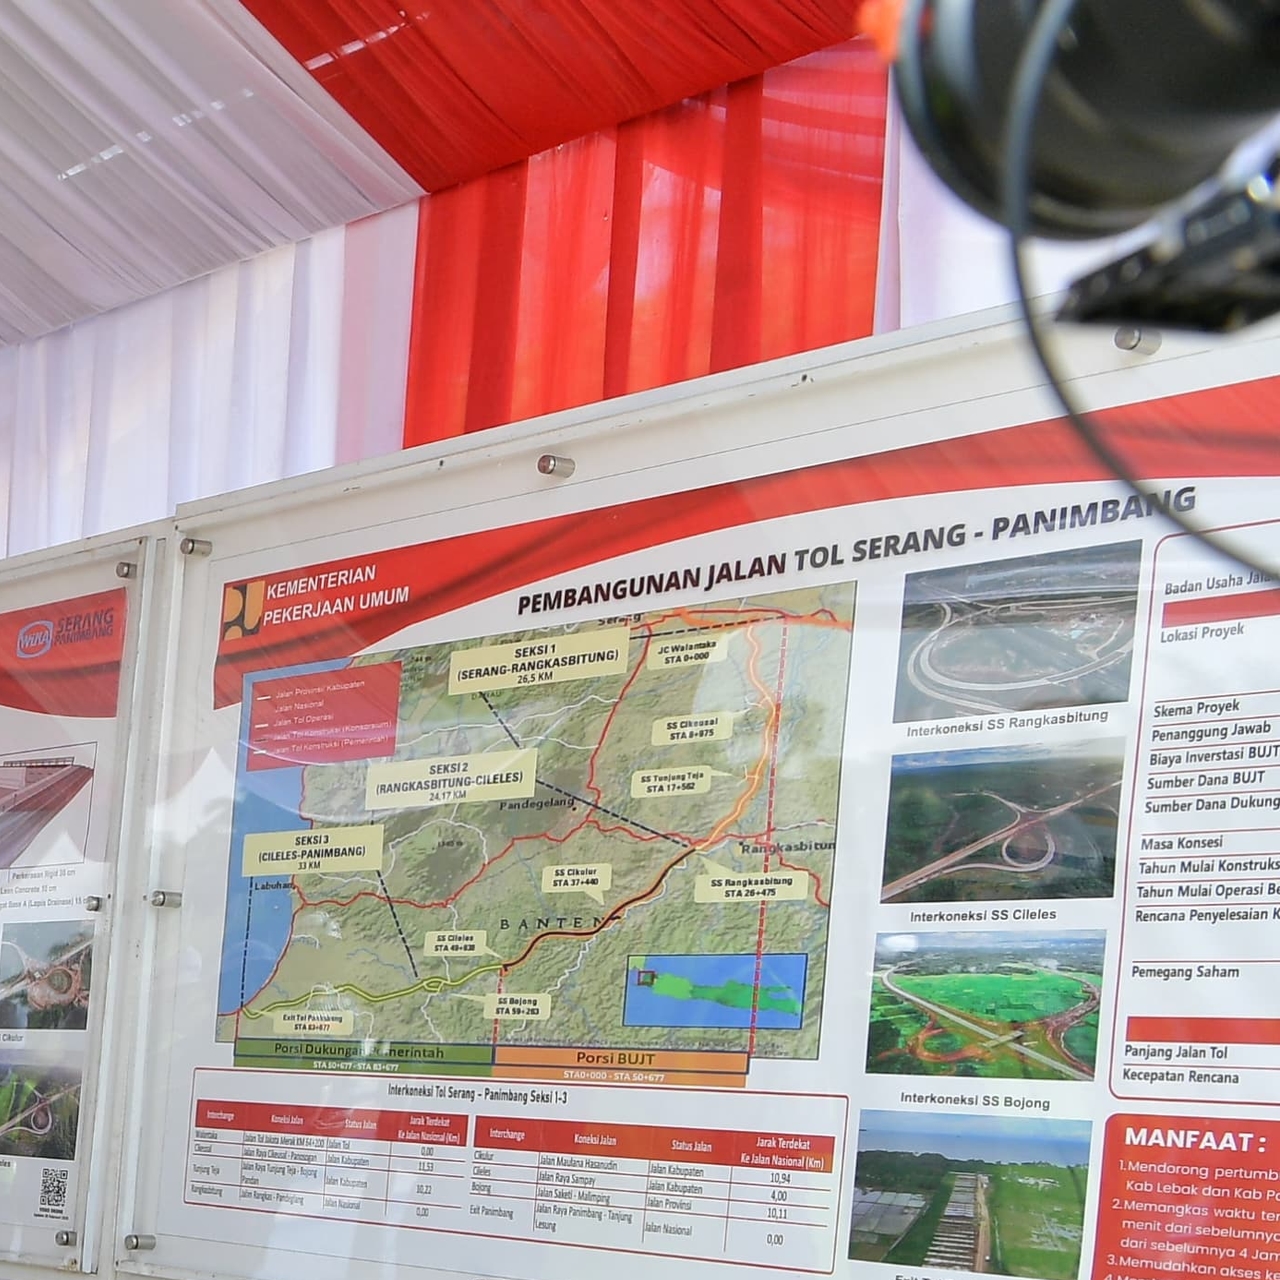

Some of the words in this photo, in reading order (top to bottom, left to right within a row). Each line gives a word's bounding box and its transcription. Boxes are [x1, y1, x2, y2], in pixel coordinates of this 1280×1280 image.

[517, 567, 701, 615] PEMBANGUNAN
[704, 553, 787, 591] JALAN
[795, 544, 845, 570] TOL
[851, 523, 966, 563] SERANG
[991, 486, 1196, 540] PANIMBANG
[267, 565, 376, 600] KEMENTERIAN
[1164, 580, 1202, 596] Badan
[1206, 575, 1243, 591] Usaha
[263, 596, 354, 626] PEKERJAAN
[359, 586, 409, 609] UMUM
[1161, 627, 1198, 643] Lokasi
[1201, 623, 1244, 641] Proyek
[515, 645, 549, 658] SEKSI
[550, 645, 556, 654] 1
[658, 644, 670, 654] JC
[671, 641, 716, 653] Walantaka
[458, 650, 620, 682] (SERANG-RANGKASBITUNG)
[664, 654, 682, 664] STA
[517, 673, 536, 684] 26,5
[538, 672, 553, 681] KM
[1153, 705, 1193, 717] Skema
[1197, 699, 1240, 716] Proyek
[907, 719, 984, 738] Interkoneksi
[987, 718, 1006, 731] SS
[1009, 709, 1109, 730] Rangkasbitung
[1152, 725, 1228, 742] Penanggung
[1231, 720, 1271, 736] Jawab
[1150, 753, 1182, 768] Biaya
[1185, 747, 1244, 763] Inverstasi
[1248, 745, 1280, 759] BUJT
[429, 764, 461, 775] SEKSI
[461, 762, 469, 772] 2
[376, 772, 523, 795] (RANGKASBITUNG-CILELES)
[1147, 776, 1195, 790] Sumber
[1197, 774, 1229, 786] Dana
[1233, 770, 1266, 784] BUJT
[500, 798, 575, 811] Pandegelang
[1145, 800, 1192, 813] Sumber
[1195, 798, 1227, 810] Dana
[295, 836, 322, 846] SEKSI
[322, 835, 329, 844] 3
[1141, 838, 1173, 851] Masa
[1177, 835, 1223, 849] Konsesi
[259, 846, 366, 863] (CILELES-PANIMBANG)
[297, 862, 306, 870] 33
[308, 861, 321, 870] KM
[1140, 862, 1176, 874] Tahun
[1180, 859, 1215, 873] Mulai
[711, 879, 722, 887] SS
[725, 876, 793, 887] Rangkasbitung
[725, 889, 742, 897] STA
[744, 888, 777, 897] 26+475
[1137, 886, 1173, 898] Tahun
[1178, 884, 1212, 897] Mulai
[1215, 882, 1264, 899] Operasi
[910, 910, 987, 923] Interkoneksi
[991, 910, 1009, 920] SS
[1013, 909, 1057, 920] Cileles
[1136, 910, 1185, 923] Rencana
[1189, 908, 1268, 925] Penyelesaian
[1132, 965, 1192, 981] Pemegang
[1196, 966, 1240, 978] Saham
[274, 1043, 302, 1053] Porsi
[1125, 1045, 1173, 1060] Panjang
[1176, 1045, 1206, 1058] Jalan
[1210, 1046, 1228, 1059] Tol
[577, 1051, 614, 1065] Porsi
[618, 1053, 656, 1065] BUJT
[613, 1072, 631, 1081] STA
[632, 1072, 665, 1082] 50+677
[1123, 1068, 1185, 1083] Kecepatan
[1188, 1070, 1239, 1084] Rencana
[388, 1082, 434, 1098] Interkoneksi
[435, 1084, 446, 1098] Tol
[448, 1087, 475, 1102] Serang
[484, 1088, 527, 1105] Panimbang
[530, 1091, 553, 1104] Seksi
[555, 1091, 568, 1104] 1-3
[901, 1092, 979, 1106] Interkoneksi
[982, 1095, 1000, 1106] SS
[1004, 1096, 1050, 1110] Bojong
[574, 1133, 598, 1145] Koneksi
[599, 1135, 617, 1146] Jalan
[671, 1140, 692, 1150] Status
[694, 1142, 712, 1152] Jalan
[756, 1137, 776, 1148] Jarak
[778, 1139, 810, 1151] Terdekat
[751, 1155, 771, 1165] Jalan
[772, 1155, 804, 1167] Nasional
[805, 1158, 825, 1170] (Km)
[668, 1165, 704, 1178] Kabupaten
[770, 1172, 791, 1184] 10,94
[1215, 1168, 1280, 1182] pertumb
[771, 1191, 787, 1202] 4,00
[1126, 1180, 1153, 1192] Kab
[1157, 1182, 1198, 1195] Lebak
[1202, 1186, 1230, 1197] dan
[1234, 1188, 1262, 1200] Kab
[767, 1208, 787, 1220] 10,11
[1214, 1207, 1255, 1220] waktu
[1122, 1219, 1161, 1231] menit
[1165, 1223, 1192, 1234] dari
[767, 1234, 784, 1245] 0,00
[1120, 1237, 1147, 1248] dari
[1151, 1241, 1235, 1259] sebelumnya
[1239, 1248, 1248, 1258] 4
[1220, 1265, 1261, 1280] akses
